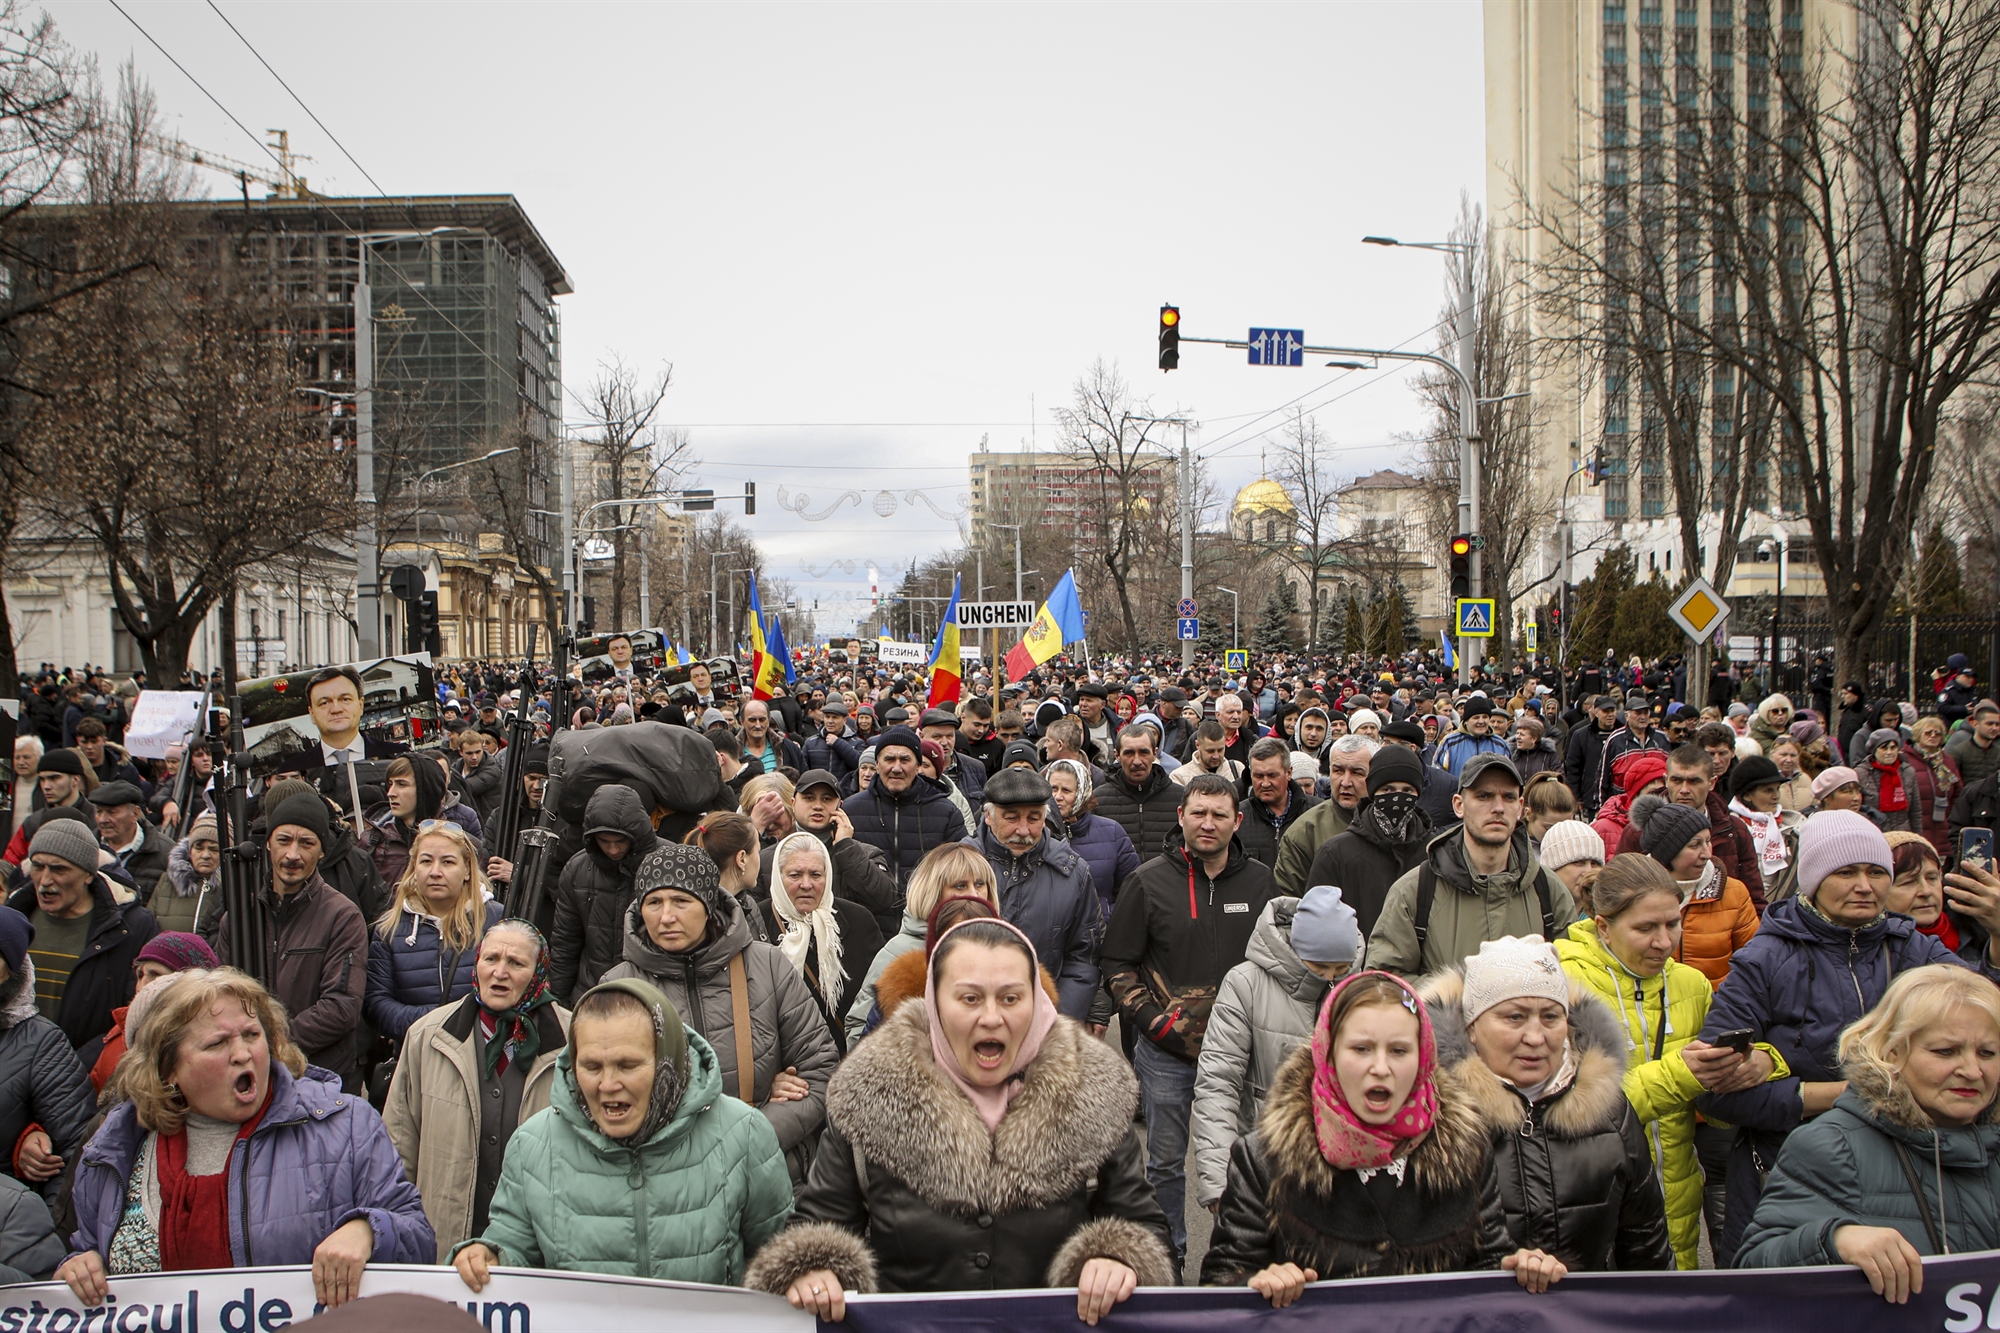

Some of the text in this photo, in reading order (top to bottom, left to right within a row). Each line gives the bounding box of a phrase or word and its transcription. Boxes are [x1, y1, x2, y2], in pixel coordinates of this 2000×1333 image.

[959, 604, 1032, 625] UNGHENI
[883, 647, 920, 658] РЕЗИНА
[219, 1287, 293, 1333] de
